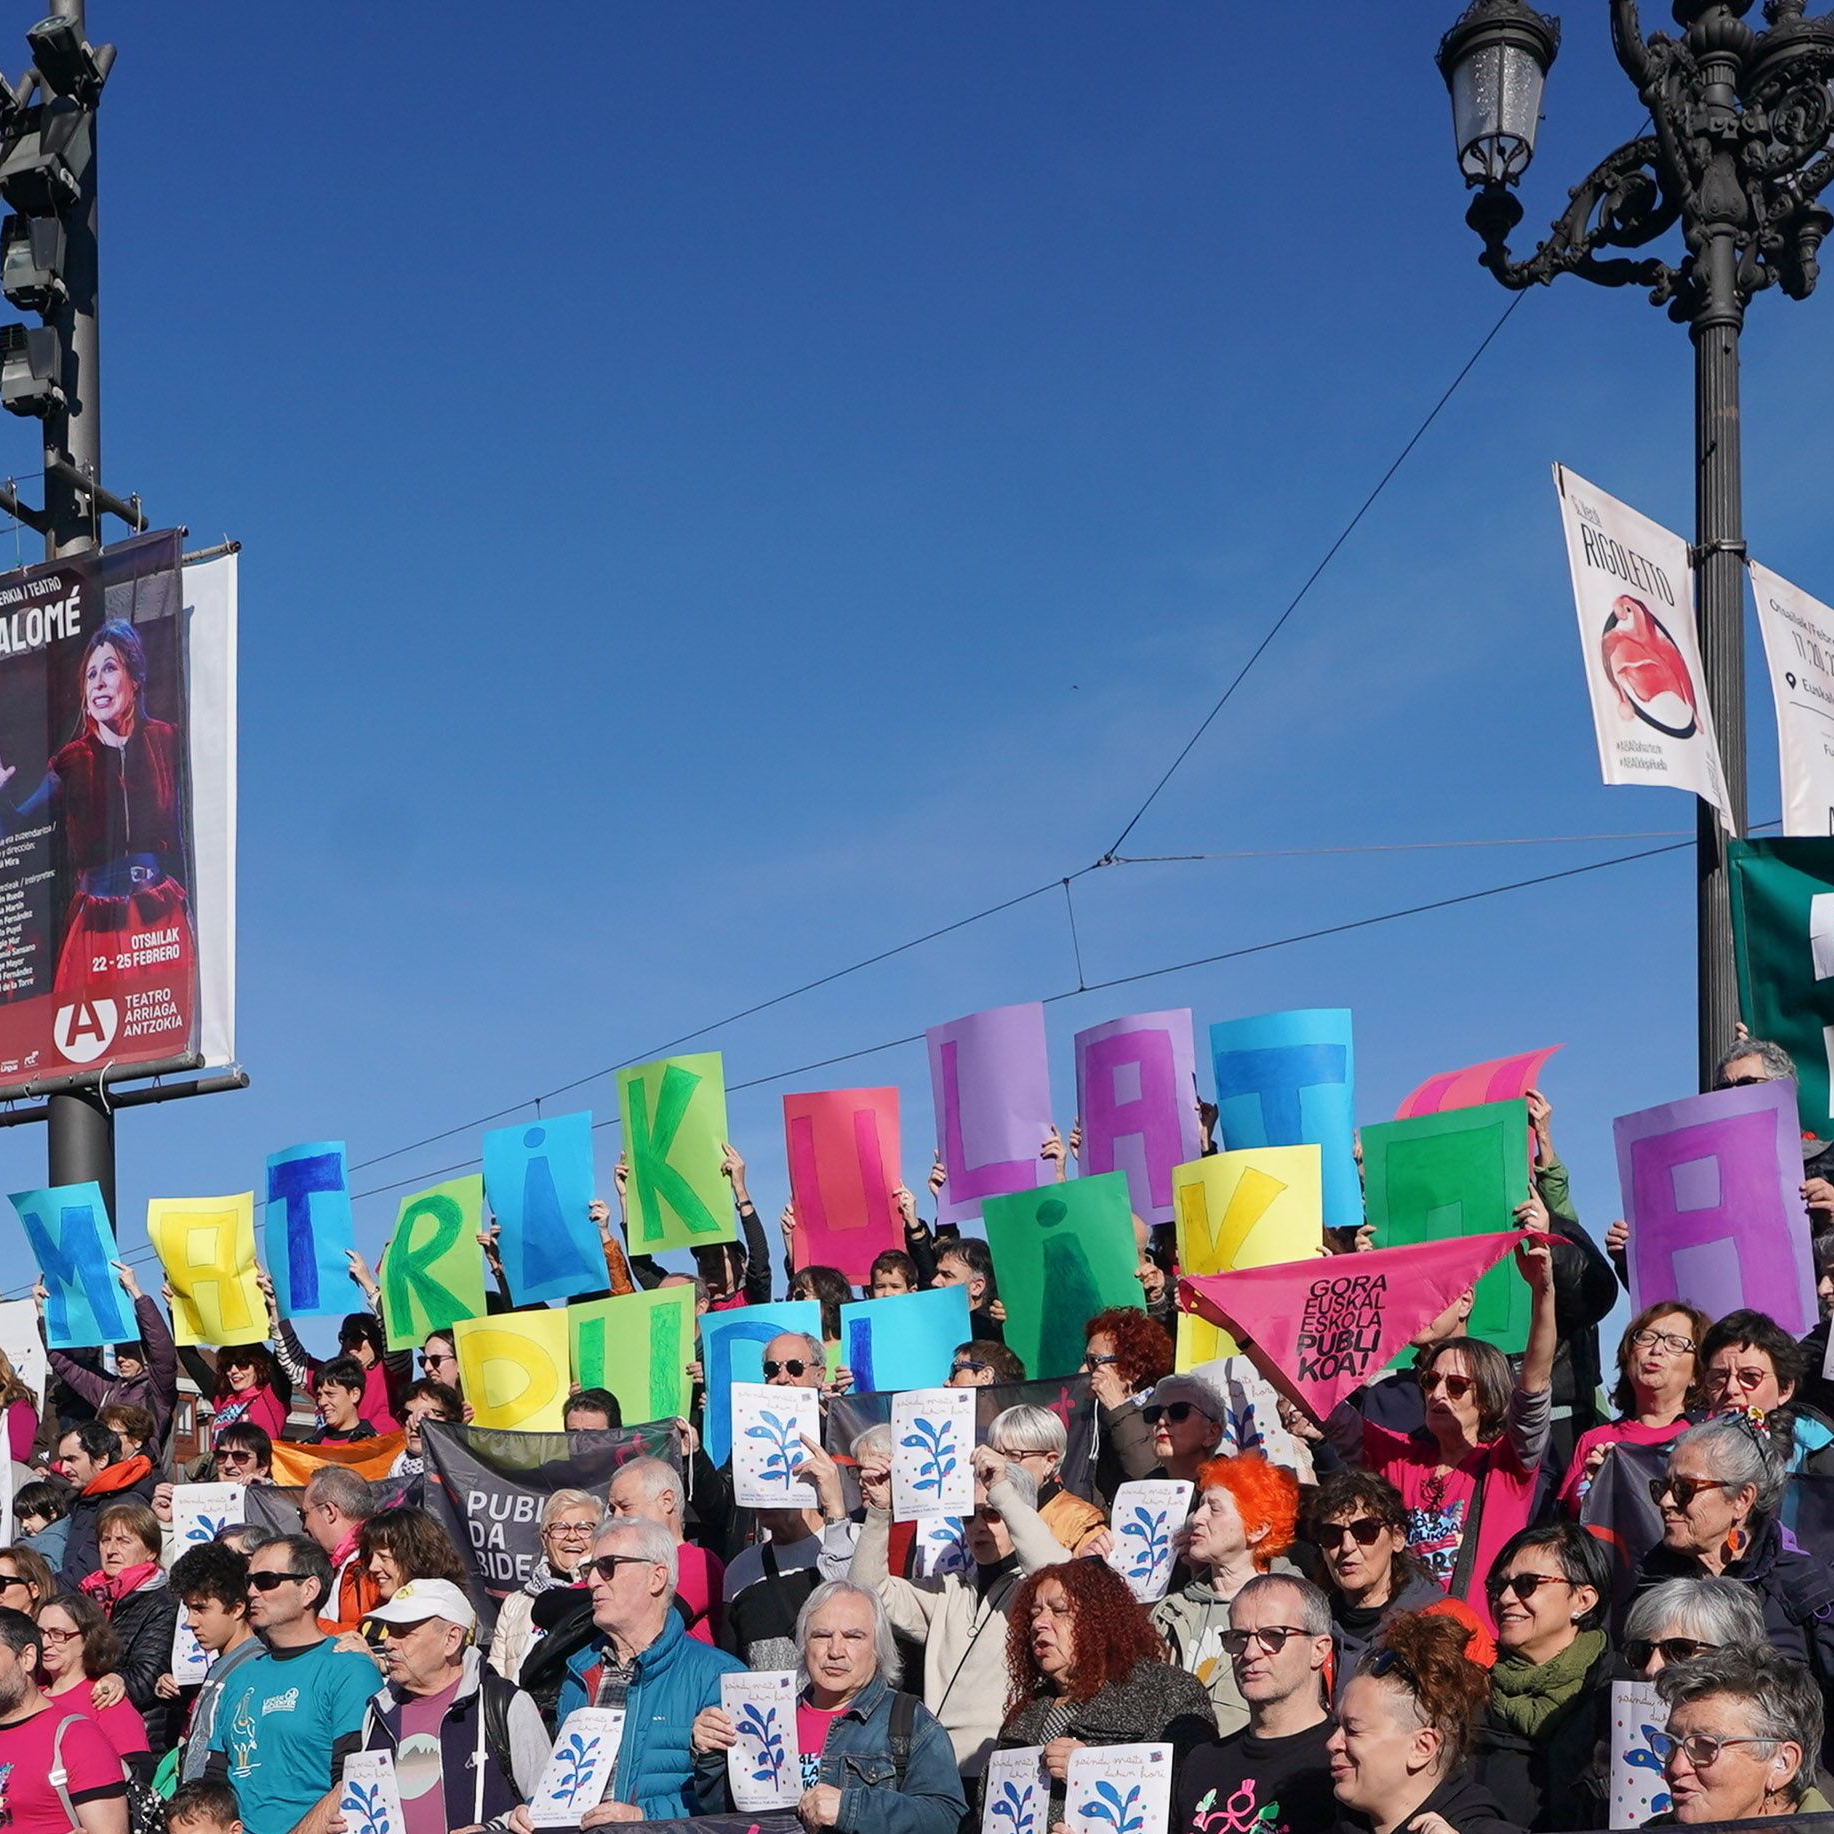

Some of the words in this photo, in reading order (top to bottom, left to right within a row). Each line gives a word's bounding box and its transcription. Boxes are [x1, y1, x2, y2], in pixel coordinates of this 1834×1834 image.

[1581, 522, 1676, 608] RIGOLETTO
[28, 576, 63, 599] TEATRO
[131, 927, 180, 950] OTSAILAK
[92, 956, 108, 972] 22
[116, 952, 133, 969] 25
[132, 944, 180, 967] FEBRERO
[124, 987, 172, 1009] TEATRO
[124, 1001, 178, 1024] ARRIAGA
[123, 1014, 184, 1038] ANTZOKIA
[1309, 1273, 1388, 1298] GORA
[1303, 1291, 1386, 1316] EUSKAL
[1300, 1310, 1383, 1334] ESKOLA
[1295, 1328, 1382, 1358] PUBLI
[1297, 1351, 1370, 1383] KOA!
[468, 1519, 506, 1551] DA
